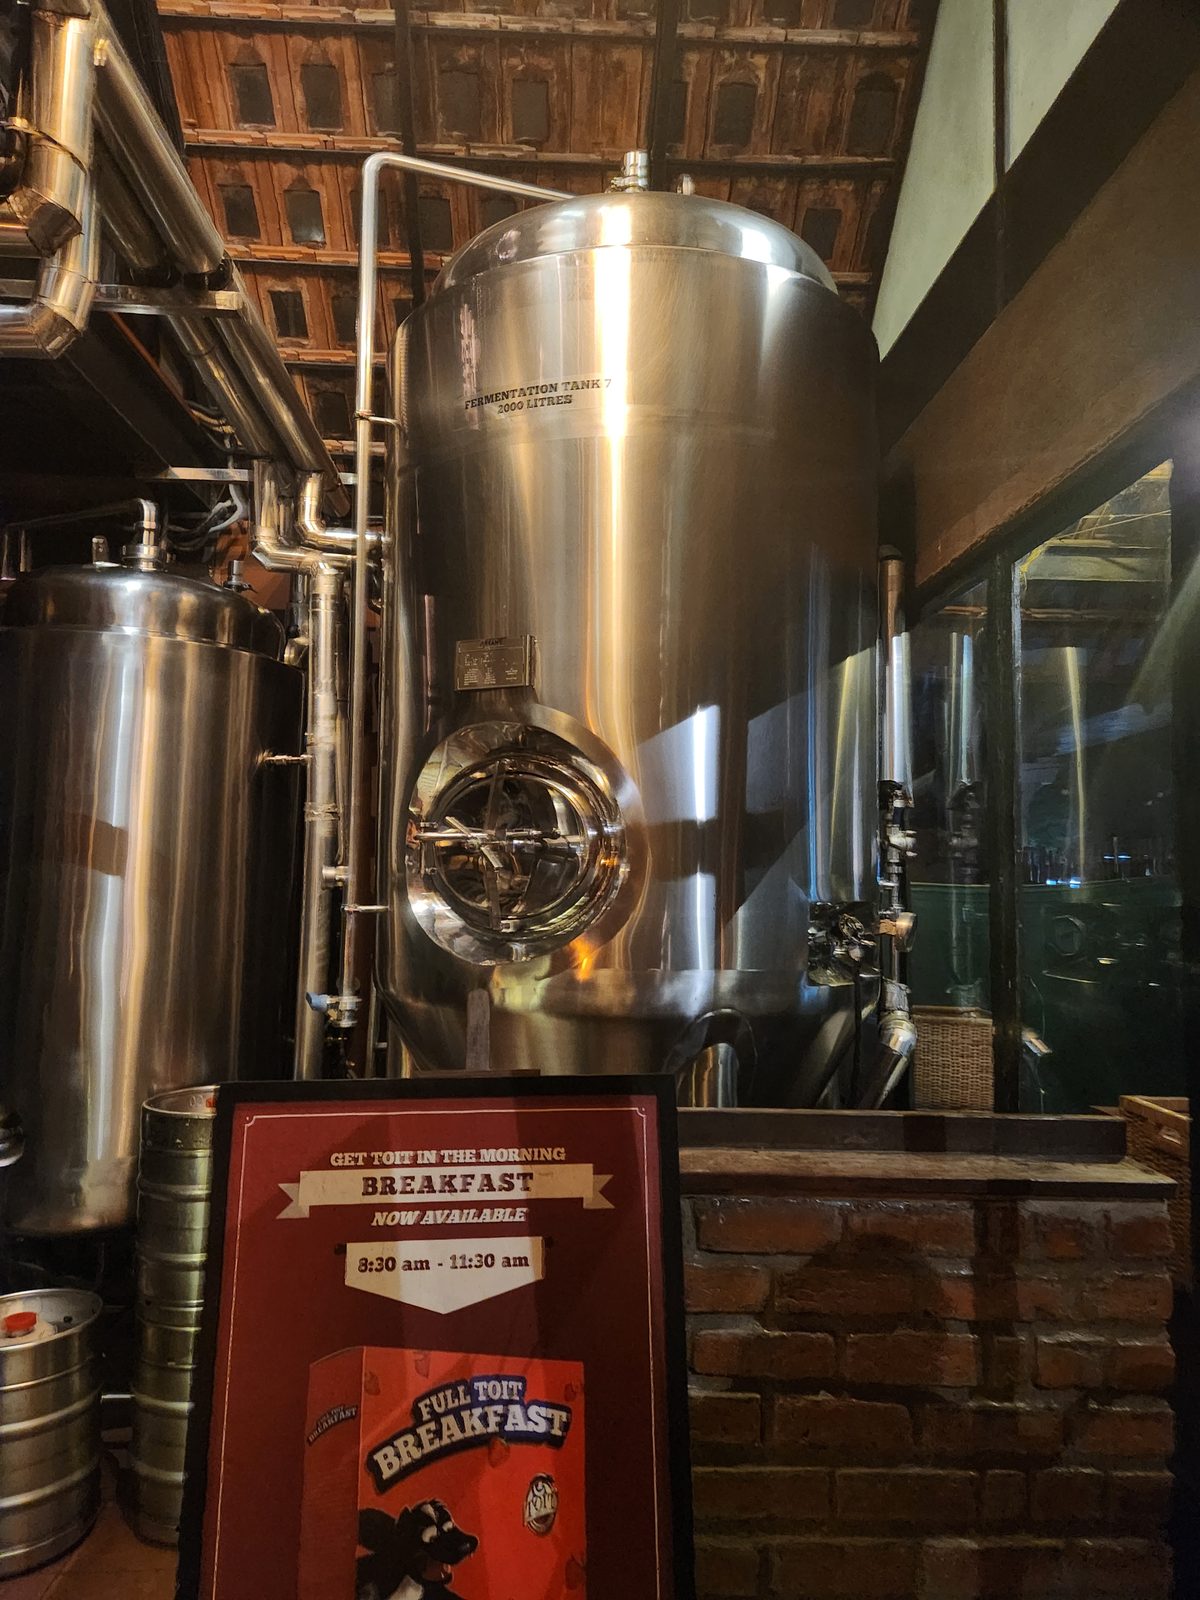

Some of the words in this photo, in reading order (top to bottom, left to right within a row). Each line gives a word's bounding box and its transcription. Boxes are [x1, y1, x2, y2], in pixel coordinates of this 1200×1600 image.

[464, 382, 558, 410] FERMENTATION
[561, 378, 601, 392] TANK
[604, 378, 612, 389] 7
[497, 400, 524, 415] 2000
[526, 394, 573, 409] LITRES
[330, 1152, 367, 1167] GET
[371, 1150, 414, 1166] TOIT
[416, 1149, 437, 1164] IN
[440, 1148, 477, 1164] THE
[479, 1147, 566, 1162] MORNING
[361, 1172, 534, 1196] BREAKFAST
[371, 1210, 421, 1227] NOW
[420, 1207, 529, 1225] AVAILABLE
[357, 1256, 397, 1273] 8:30
[402, 1258, 431, 1272] am
[449, 1253, 496, 1270] 11:30
[501, 1255, 530, 1268] am
[418, 1385, 471, 1421] FULL
[473, 1380, 522, 1401] TOIT
[373, 1403, 568, 1481] BREAKFAST
